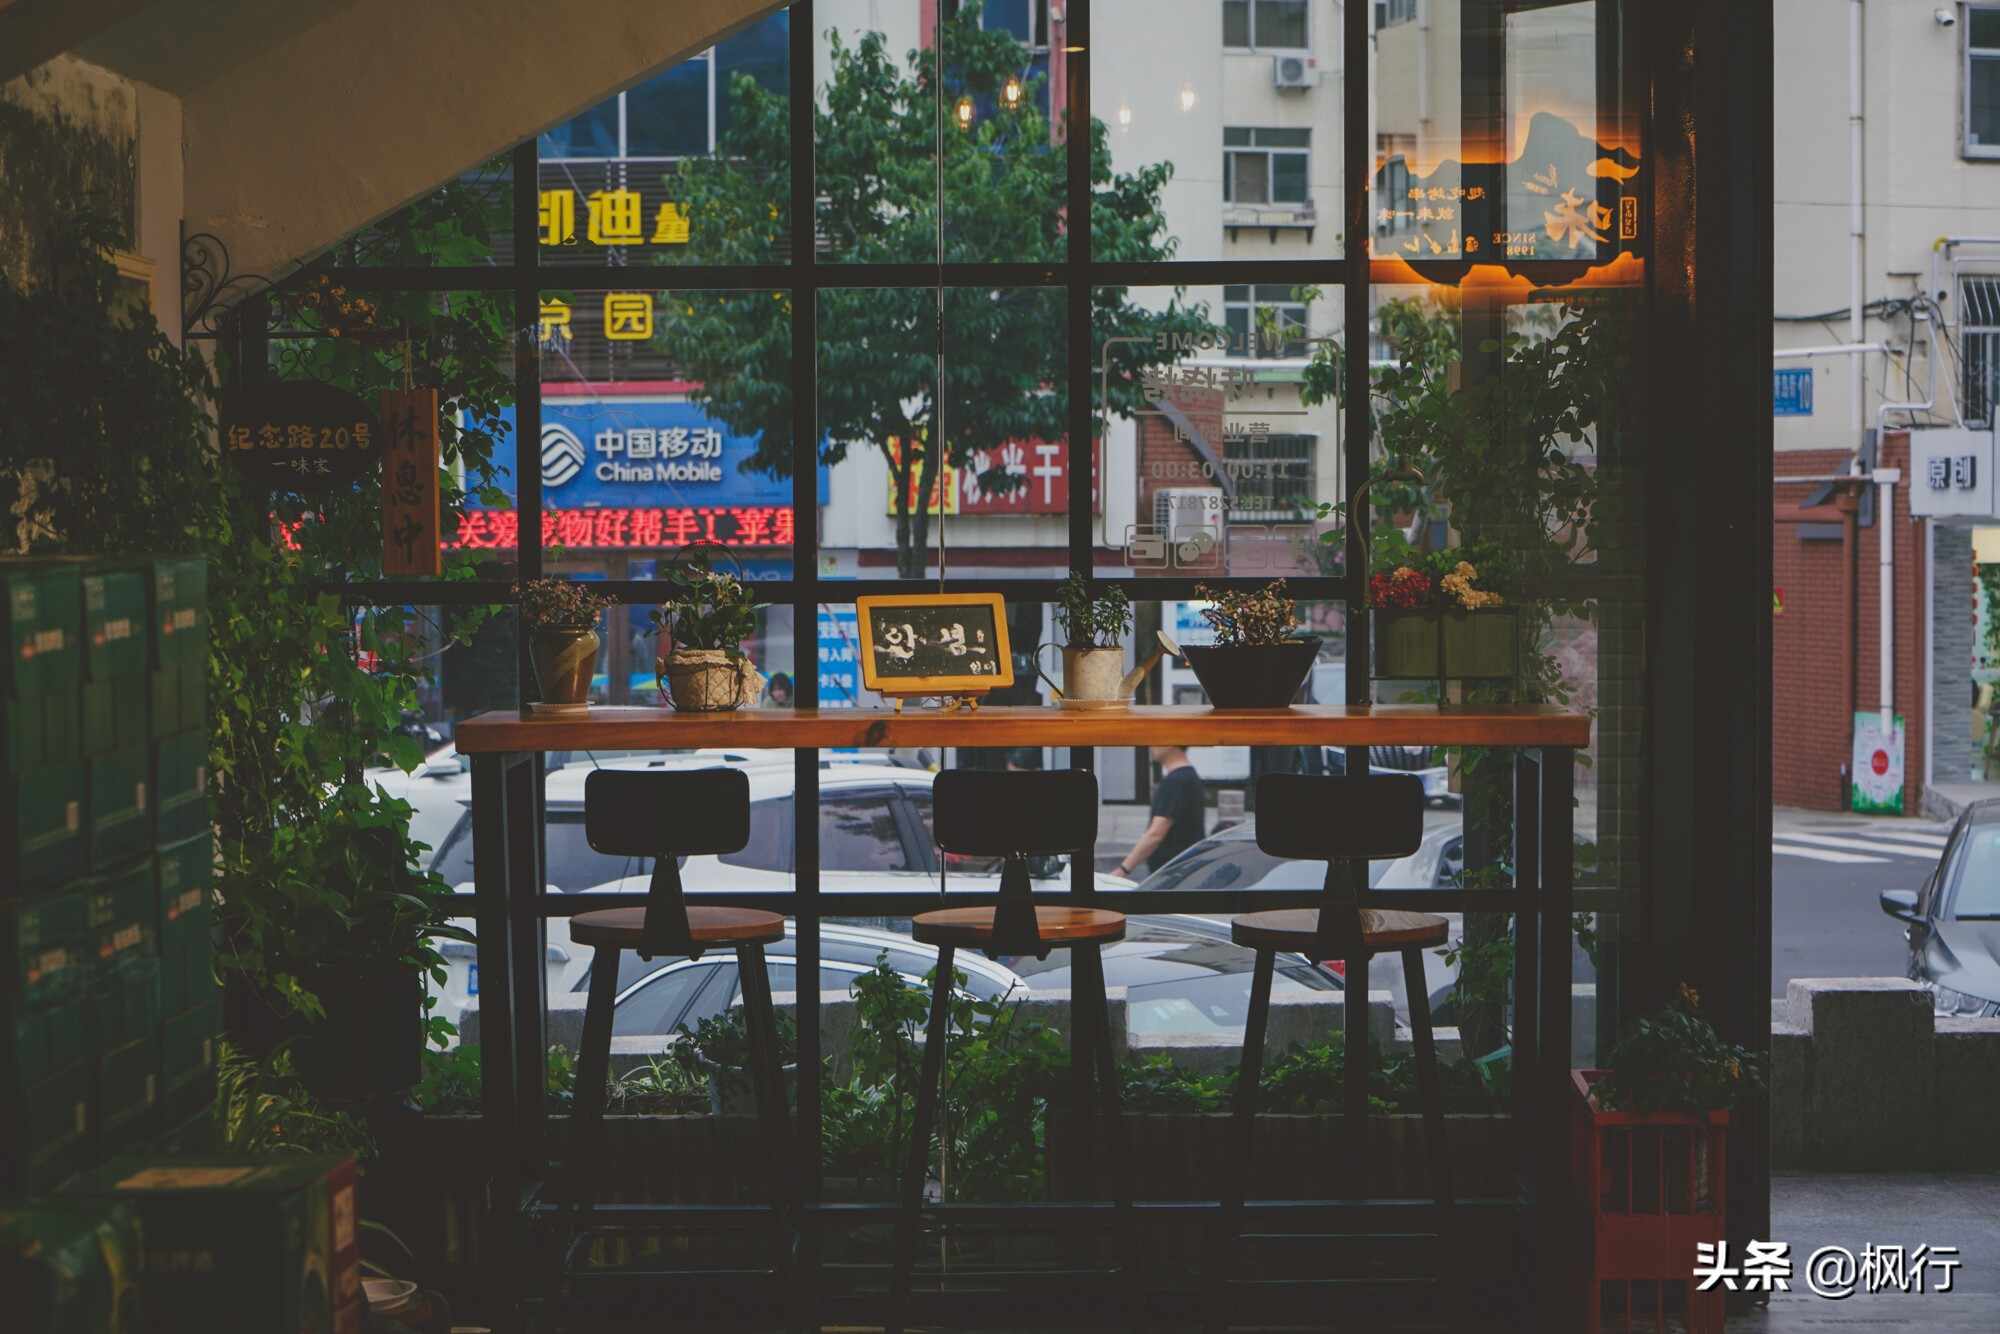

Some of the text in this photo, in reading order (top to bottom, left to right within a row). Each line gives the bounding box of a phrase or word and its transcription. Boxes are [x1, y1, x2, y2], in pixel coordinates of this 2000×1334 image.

[228, 422, 371, 449] 纪念路20号
[595, 428, 722, 459] 中国移动
[595, 462, 722, 481] China Mobile
[1928, 457, 1976, 489] 原创
